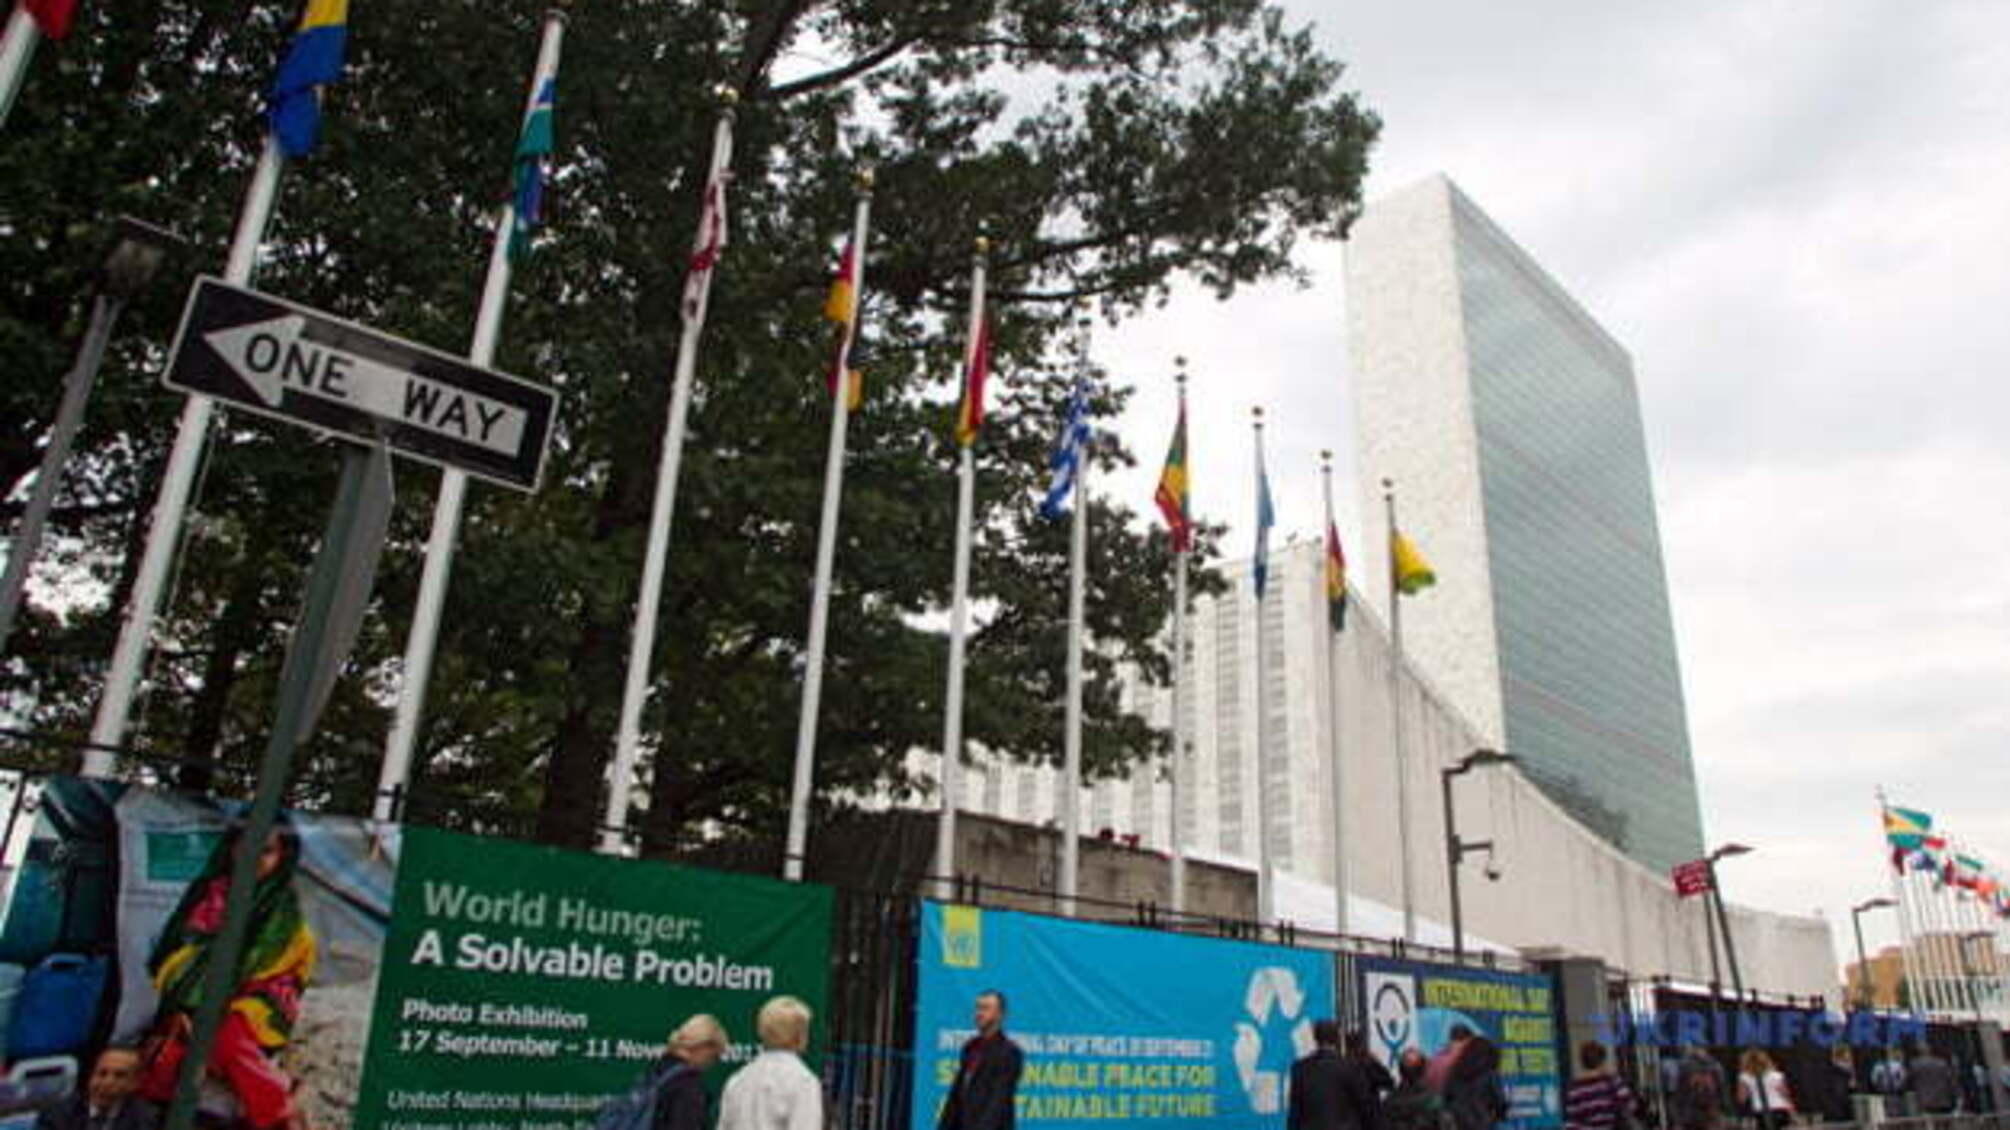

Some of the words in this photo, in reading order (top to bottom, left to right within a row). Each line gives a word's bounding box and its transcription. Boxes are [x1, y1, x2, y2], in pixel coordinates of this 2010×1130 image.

[245, 332, 357, 399] ONE
[401, 379, 506, 442] WAY
[423, 881, 546, 928] World
[557, 898, 702, 945] Hunger:
[410, 930, 443, 966] A
[455, 934, 625, 980] Solvable
[634, 951, 773, 990] Problem
[401, 999, 473, 1025] Photo
[478, 1005, 588, 1030] Exhibition
[398, 1030, 430, 1052] 17
[434, 1031, 562, 1061] September
[585, 1038, 609, 1058] 11
[1104, 1064, 1172, 1088] PEACE
[1176, 1065, 1216, 1088] FOR
[387, 1090, 449, 1109] United
[452, 1091, 521, 1110] Nations
[1013, 1094, 1131, 1119] TAINABLE
[1136, 1093, 1216, 1119] FUTURE
